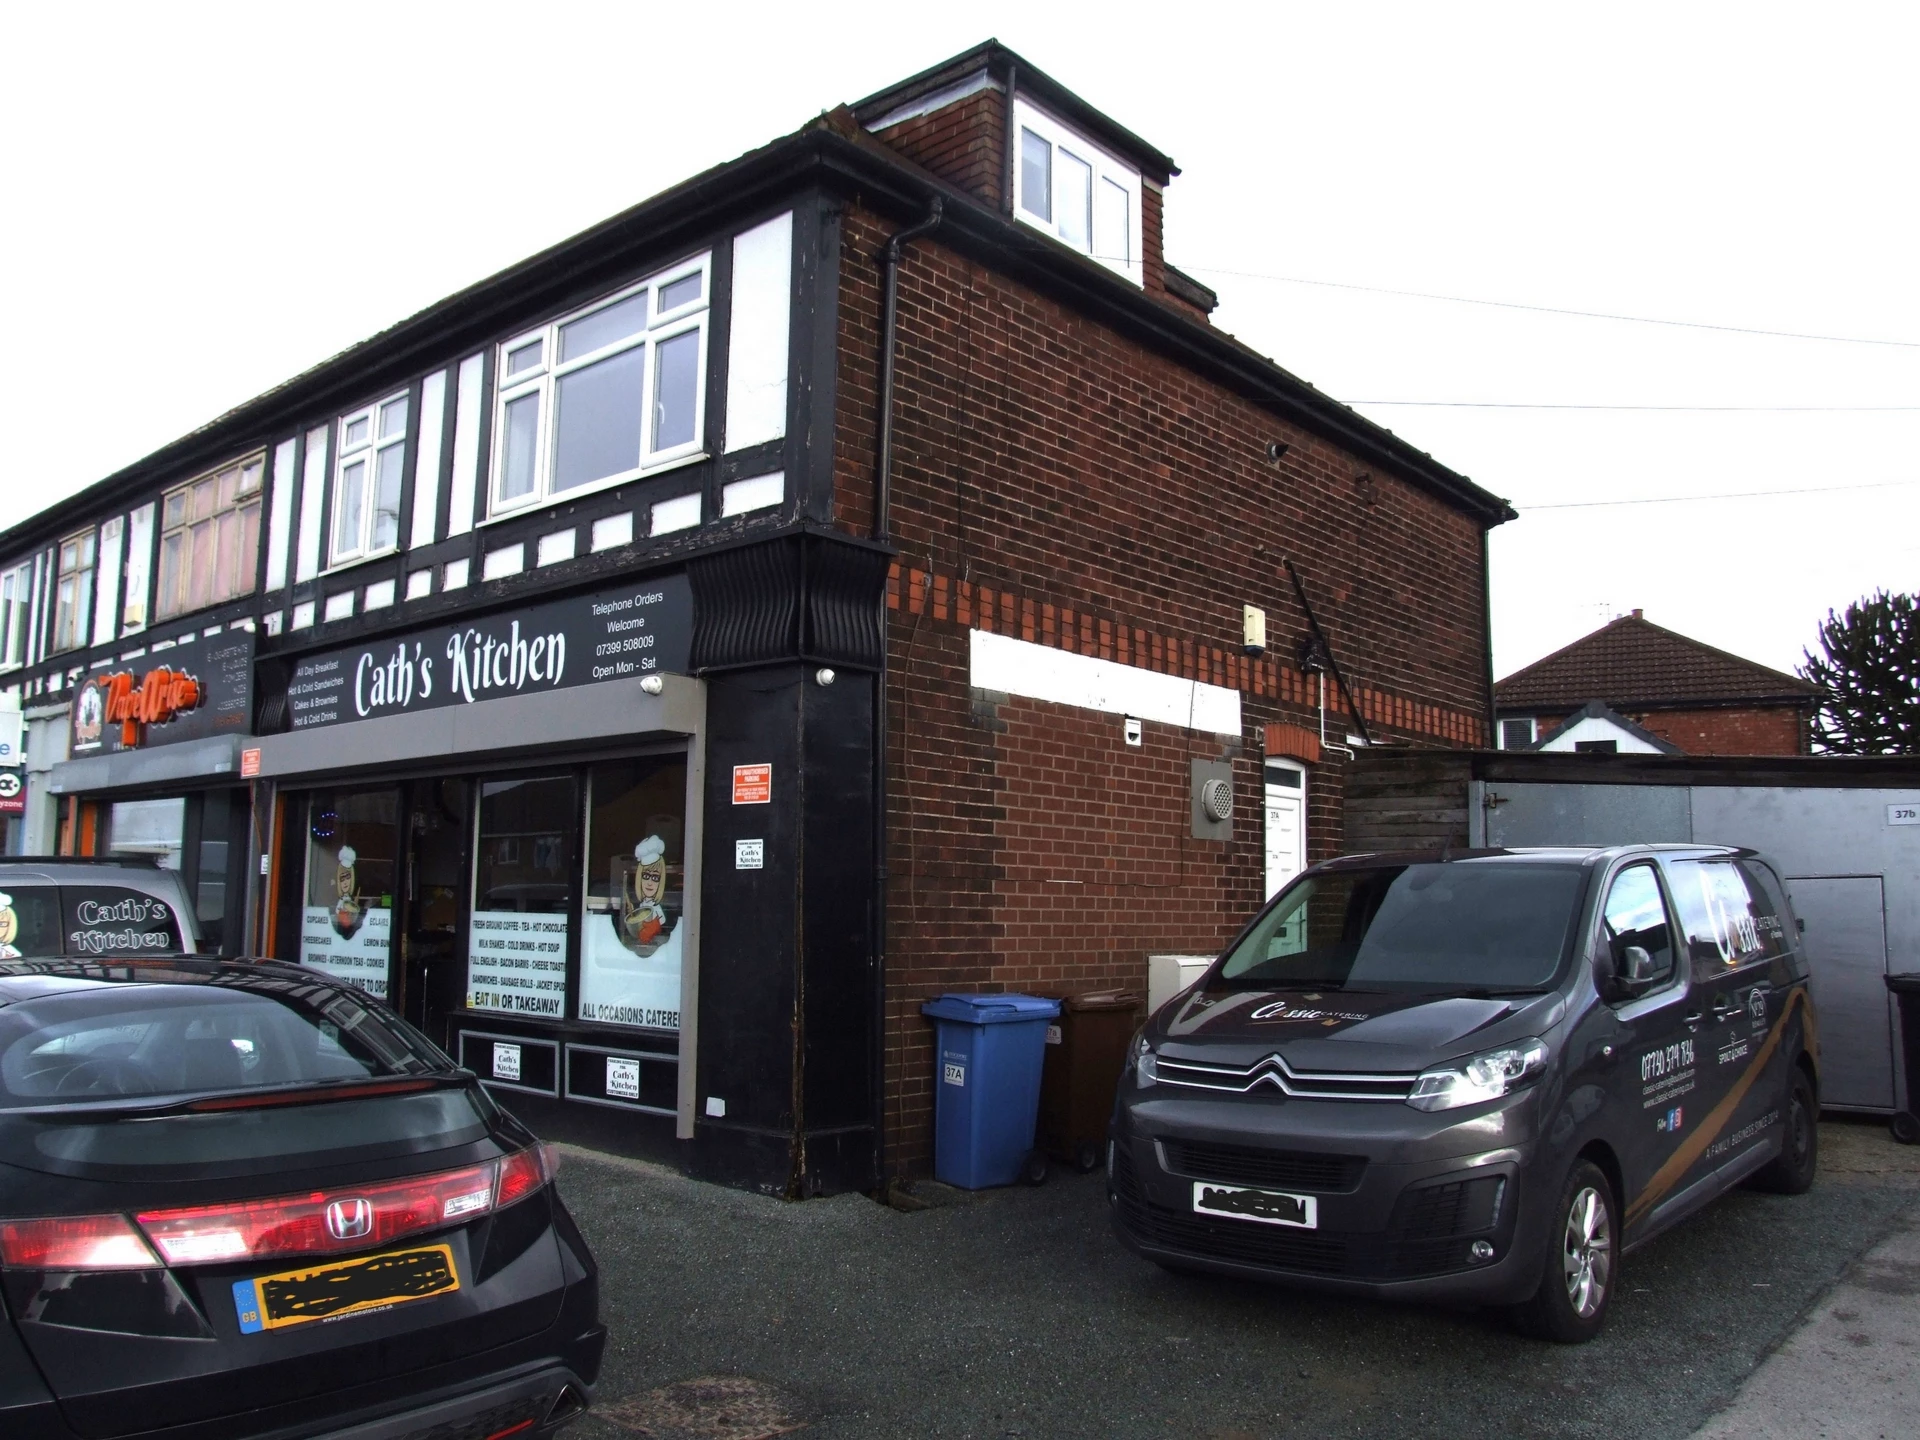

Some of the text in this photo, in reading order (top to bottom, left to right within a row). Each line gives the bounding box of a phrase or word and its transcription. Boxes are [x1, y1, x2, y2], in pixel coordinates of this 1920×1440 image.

[592, 593, 663, 616] Telephone Orders
[607, 618, 645, 633] Welcome
[596, 635, 654, 656] 07399 508009
[304, 666, 314, 677] Day
[315, 660, 339, 674] Breakfast
[355, 620, 565, 717] Cath's Kitchen
[593, 666, 614, 680] Open
[616, 662, 633, 674] Mon
[642, 657, 656, 669] Sat
[288, 678, 344, 696] Hot & Cold Sandwiches
[294, 695, 338, 710] Cakes & Brownies
[294, 711, 337, 726] Hot & Cold Drinks
[1895, 810, 1916, 818] 37b
[78, 899, 167, 925] Cath's
[473, 920, 485, 929] FRESH
[486, 921, 502, 930] GROUND
[503, 922, 519, 931] COFFEE
[522, 922, 530, 931] TEA
[533, 923, 541, 932] HOT
[543, 923, 568, 933] CHOCOLATE
[70, 928, 170, 954] Kitchen
[364, 939, 379, 947] LEMON
[508, 941, 519, 950] COLD
[520, 941, 535, 951] DRINKS
[538, 943, 547, 952] HOT
[548, 943, 560, 953] SOUP
[500, 958, 514, 968] BACON
[532, 961, 549, 970] CHEESE
[473, 974, 498, 985] SANDWICHES
[500, 977, 519, 987] SAUSAGE
[536, 980, 553, 990] JACKET
[475, 992, 489, 1006] EAT
[492, 994, 500, 1008] IN
[502, 994, 513, 1009] OR
[515, 996, 560, 1014] TAKEAWAY
[582, 1003, 680, 1028] ALL OCCASIONS CATERE
[499, 1055, 516, 1064] Cath's
[1642, 1050, 1665, 1081] 07730
[497, 1064, 519, 1074] Kitchen
[613, 1070, 635, 1080] Cath's
[946, 1067, 962, 1079] 37A
[610, 1080, 638, 1091] Kitchen
[242, 1311, 257, 1323] GB
